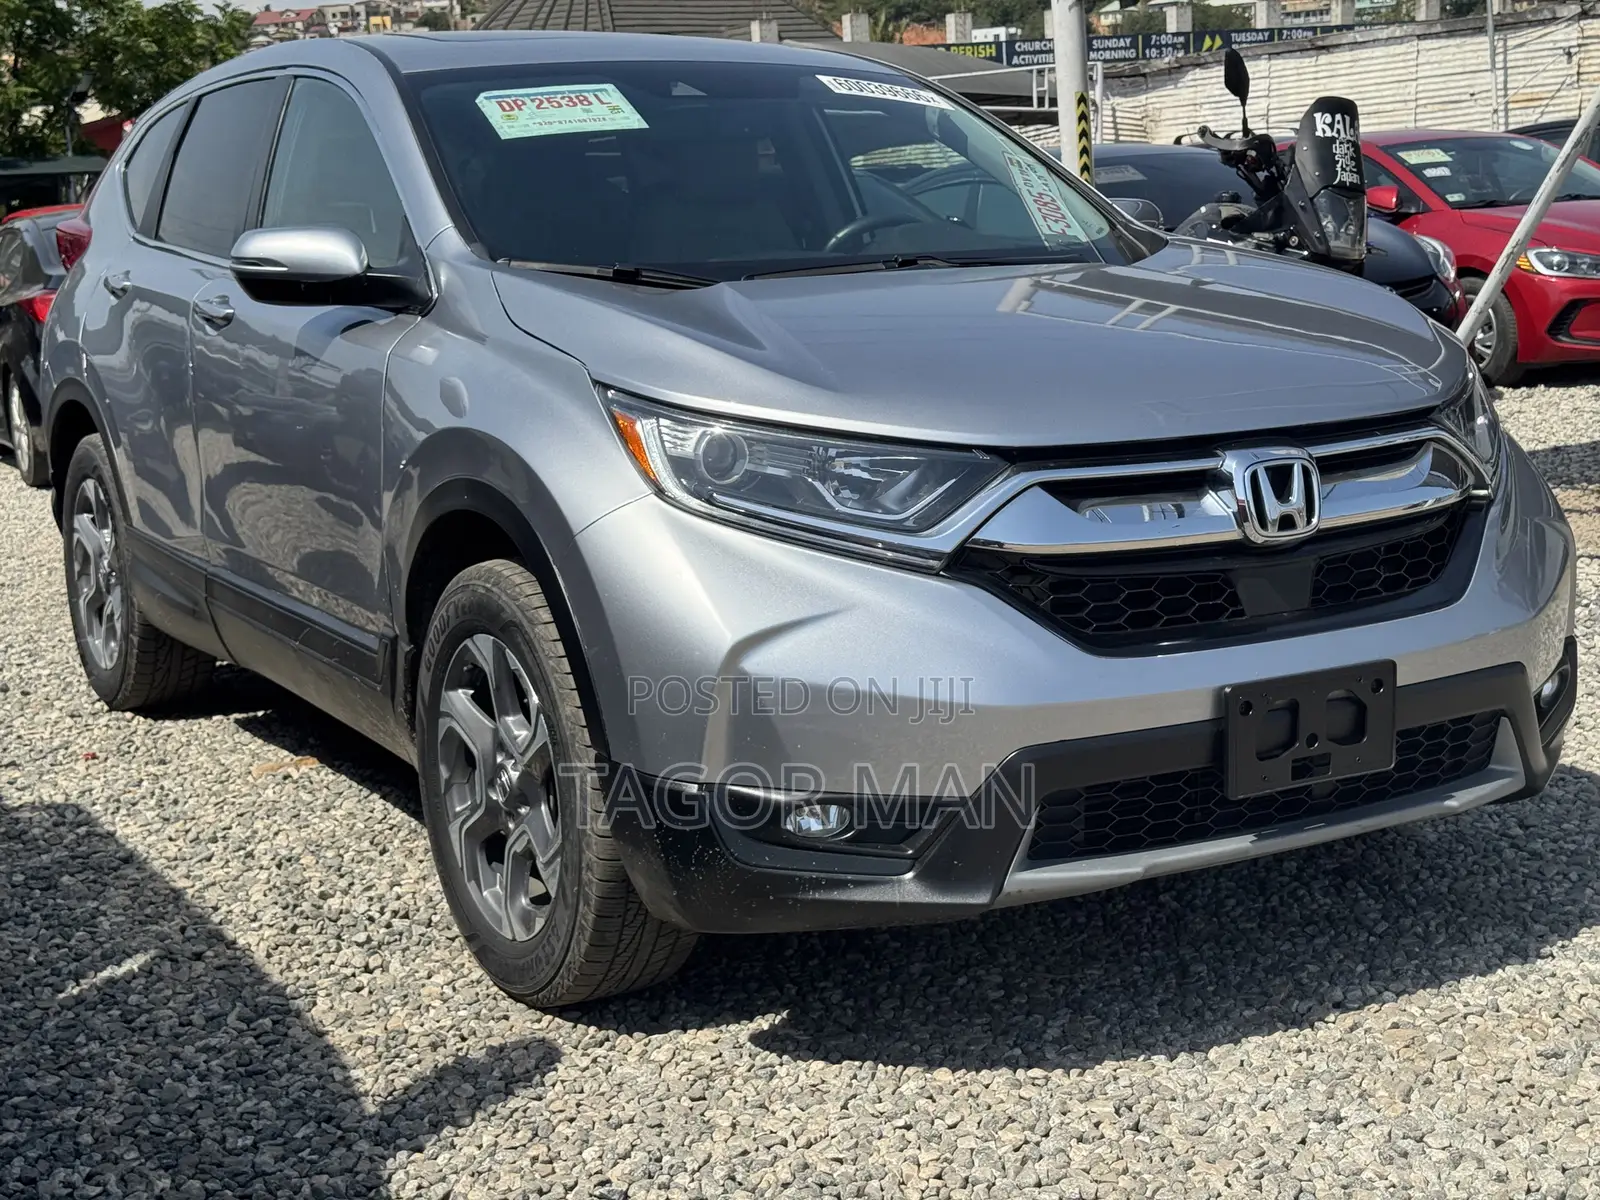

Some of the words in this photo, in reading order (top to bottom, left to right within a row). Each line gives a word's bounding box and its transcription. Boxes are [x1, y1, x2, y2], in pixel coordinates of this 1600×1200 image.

[1150, 34, 1185, 45] 7:00AM
[1230, 31, 1270, 42] TUESDAY
[1014, 41, 1054, 52] CHURCH
[1092, 38, 1132, 49] SUNDAY
[1011, 53, 1054, 65] ACTIVITIE
[1089, 49, 1136, 60] MORNING
[496, 98, 528, 112] DP
[530, 94, 593, 110] 2538
[593, 93, 612, 105] L
[1332, 140, 1356, 157] dark
[1333, 168, 1361, 186] Japan
